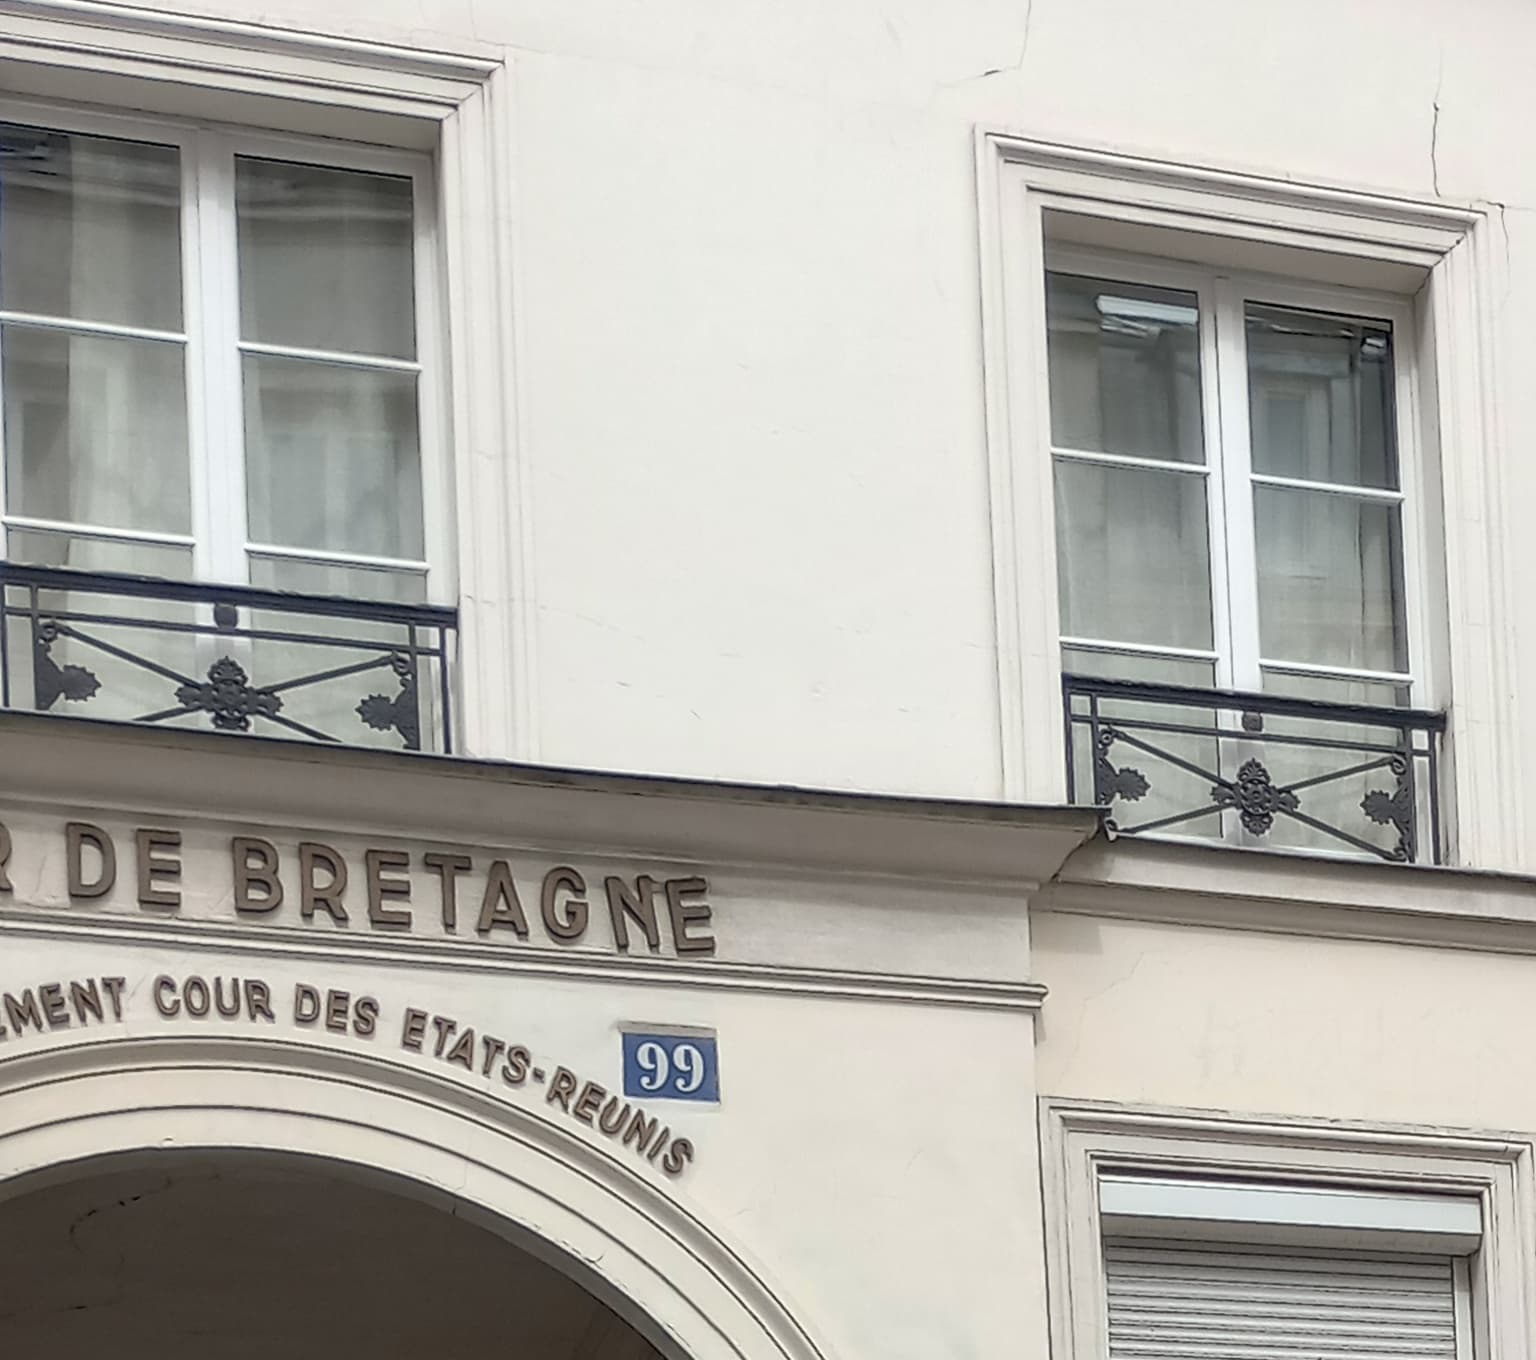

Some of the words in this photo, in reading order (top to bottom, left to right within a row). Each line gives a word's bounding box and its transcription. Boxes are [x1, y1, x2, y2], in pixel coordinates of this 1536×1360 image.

[65, 822, 182, 906] DE
[231, 836, 718, 954] BRETAGNE
[153, 975, 272, 1020] COUR
[295, 984, 379, 1036] DES
[637, 1042, 704, 1092] 99
